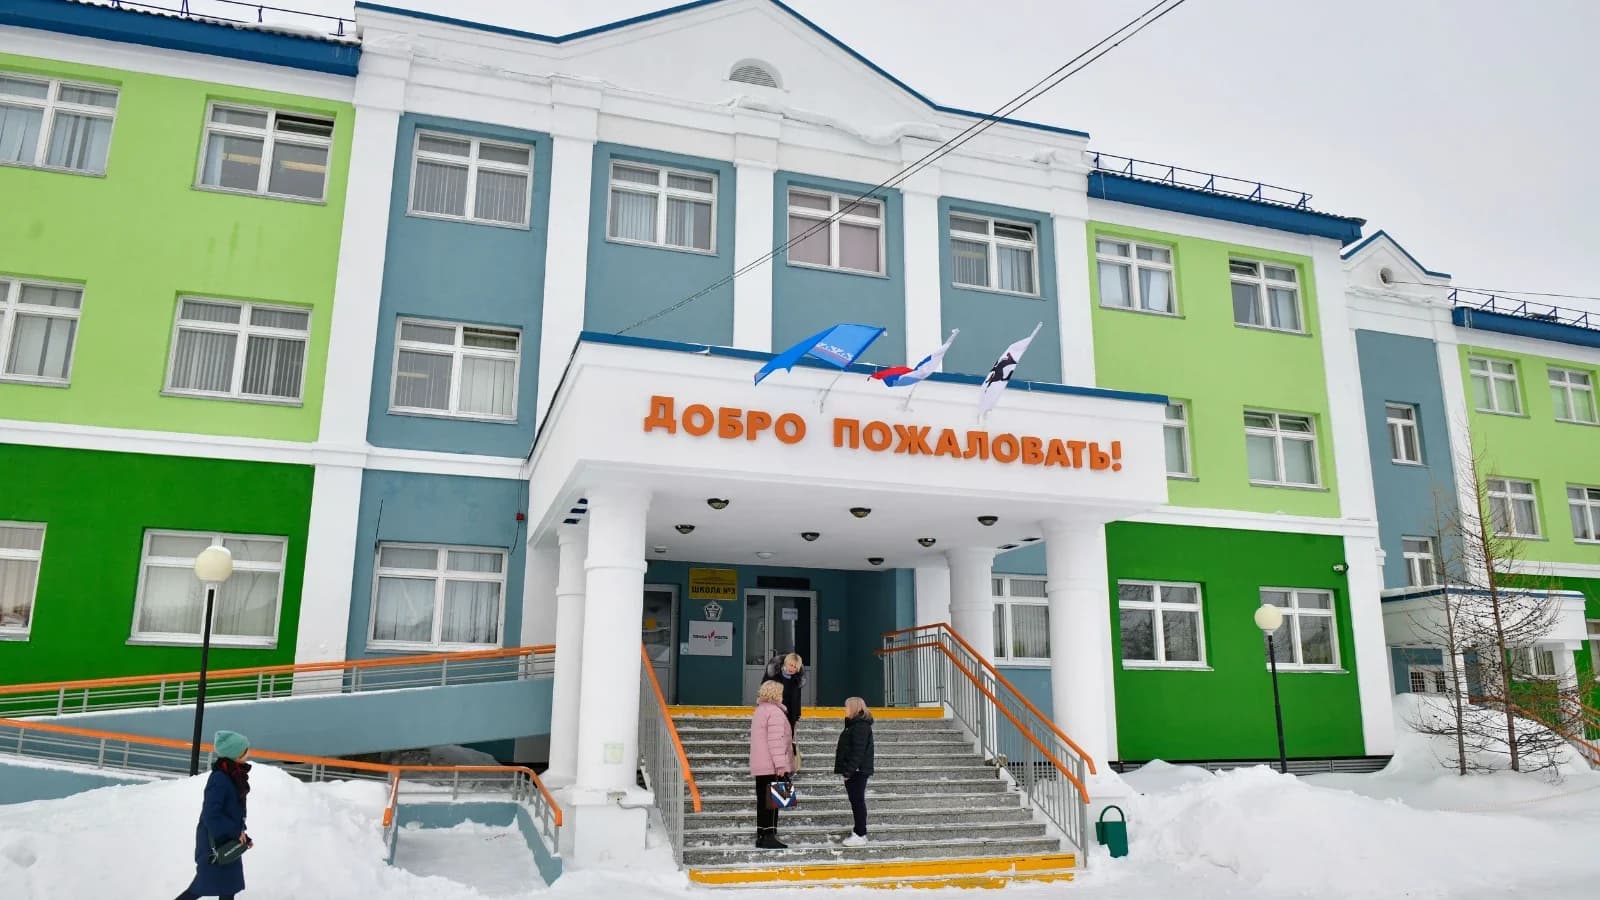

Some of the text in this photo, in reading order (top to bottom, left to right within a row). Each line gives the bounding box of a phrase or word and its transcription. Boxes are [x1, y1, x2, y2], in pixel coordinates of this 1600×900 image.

[644, 395, 1122, 472] ДОБРО ПОЖАЛОВАТЬ!
[691, 585, 721, 593] ШКОЛА
